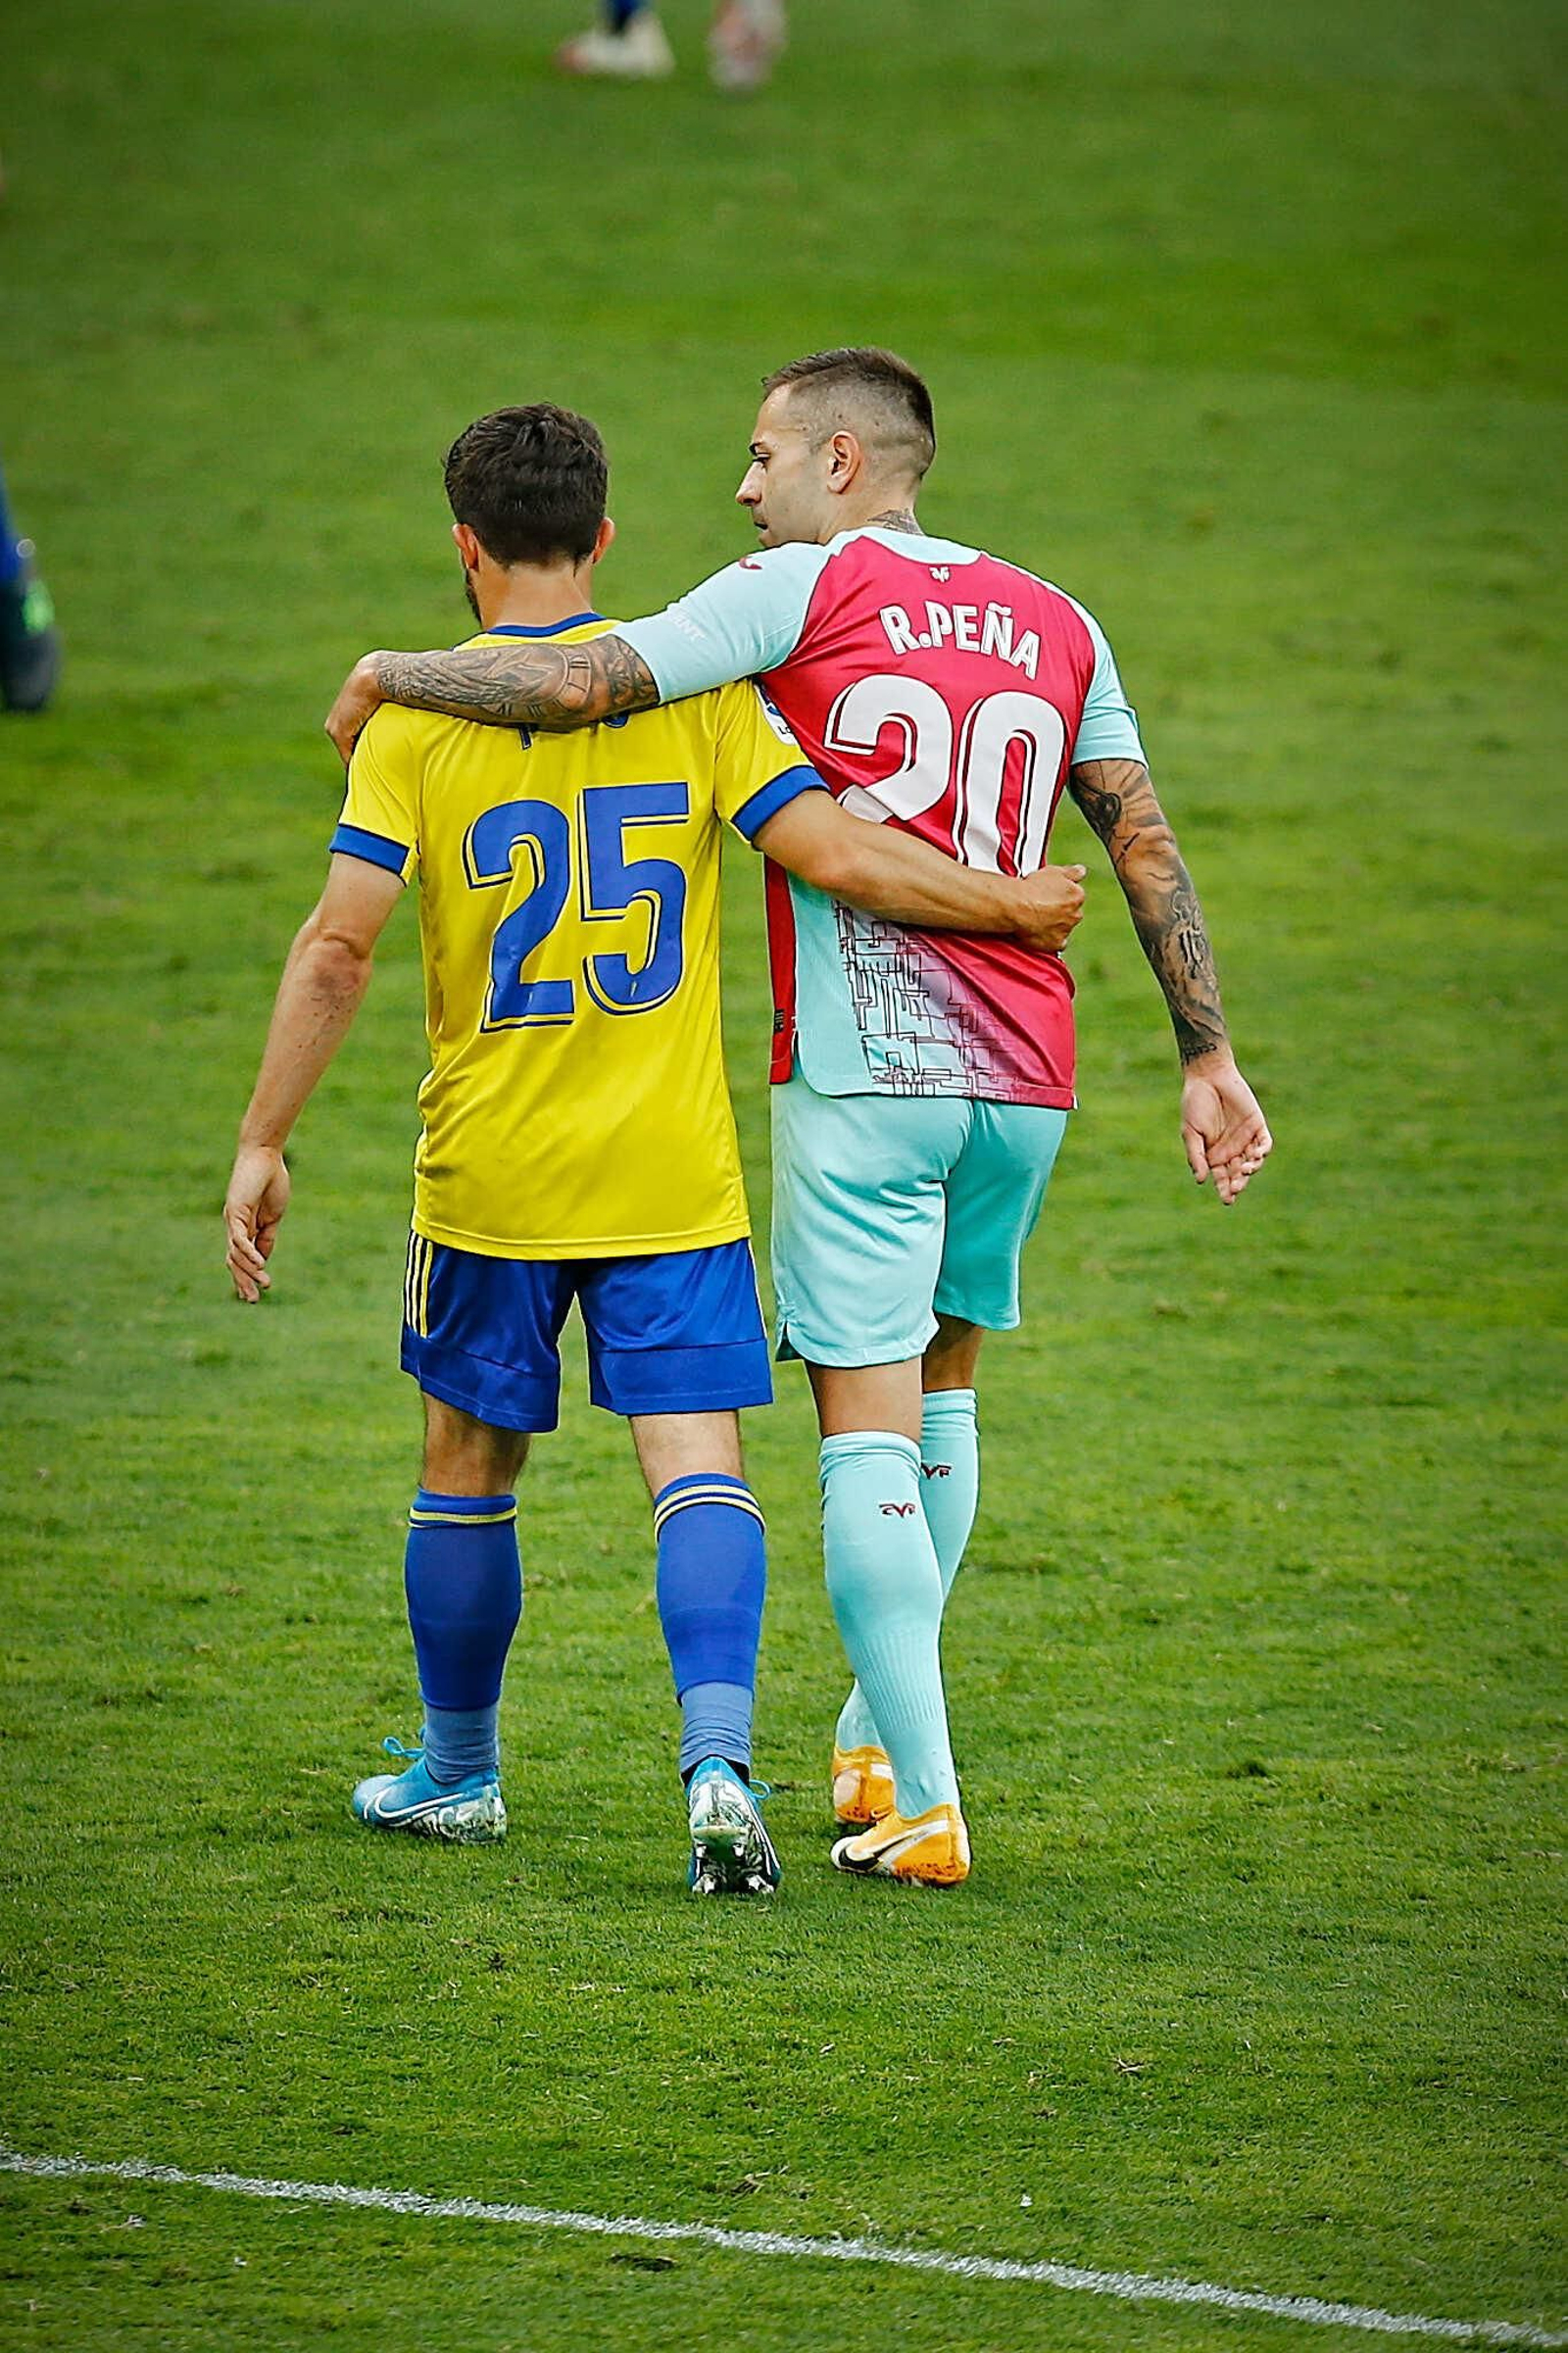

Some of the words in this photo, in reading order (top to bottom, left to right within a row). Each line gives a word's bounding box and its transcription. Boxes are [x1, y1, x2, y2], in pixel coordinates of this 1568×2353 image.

[879, 600, 1041, 680] R.PEÑA
[823, 673, 1066, 877] 20
[462, 782, 690, 1033] 25
